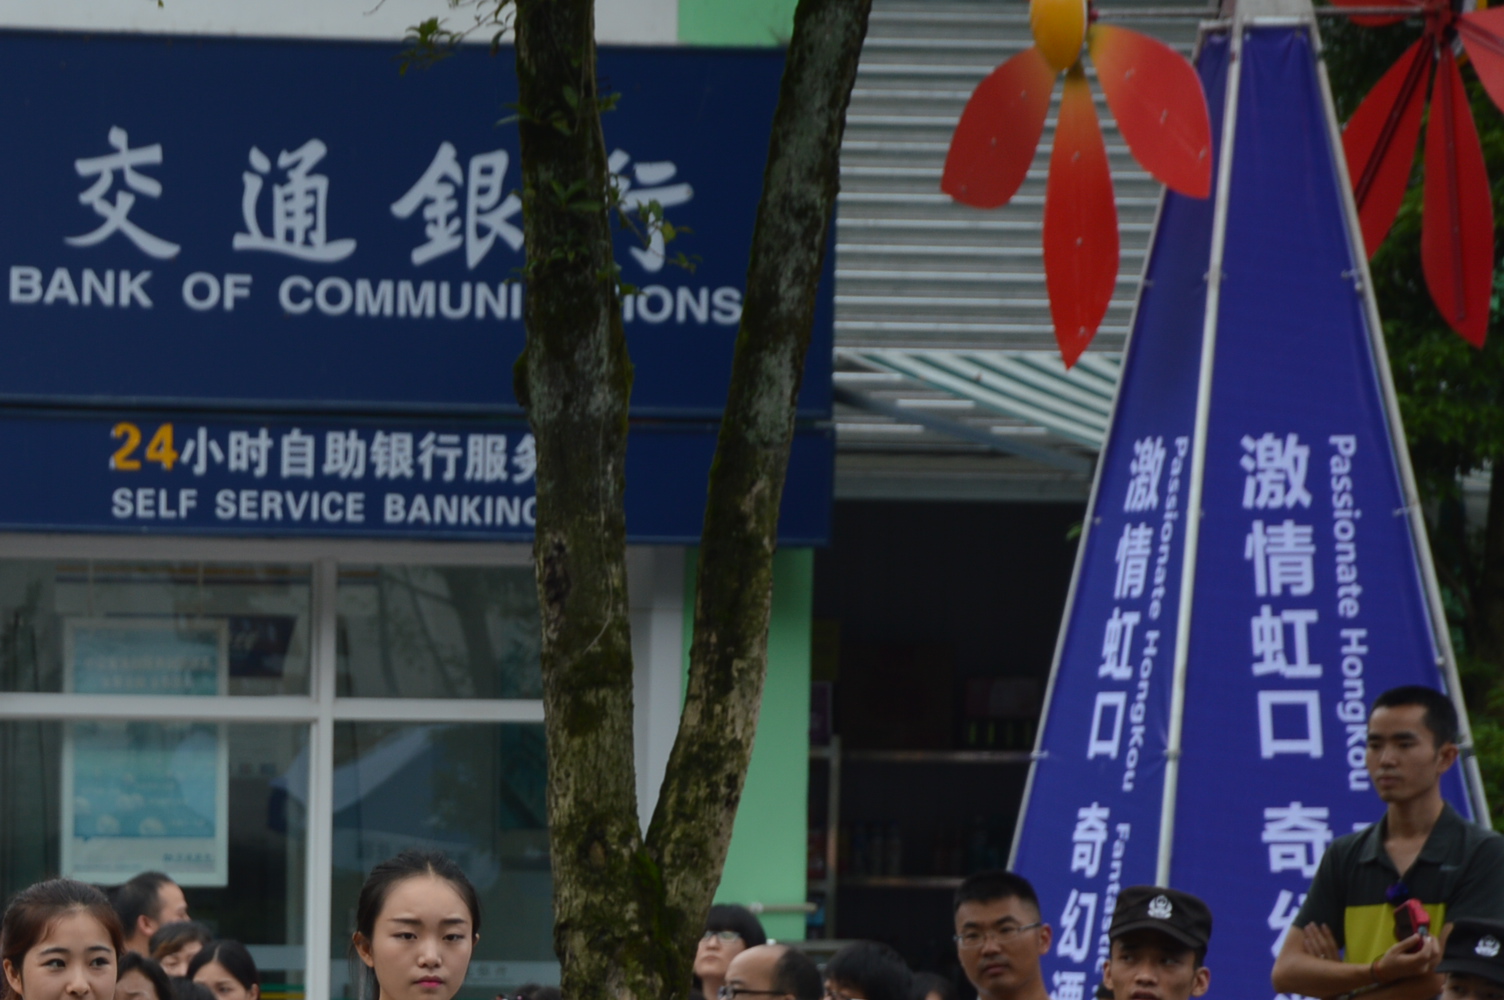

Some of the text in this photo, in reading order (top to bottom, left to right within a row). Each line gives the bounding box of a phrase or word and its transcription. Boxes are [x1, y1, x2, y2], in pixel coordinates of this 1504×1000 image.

[8, 265, 745, 326] BANK OF COMMUNIIONS
[111, 487, 199, 520] SELF
[215, 489, 366, 524] SERVICE
[1087, 434, 1165, 761] 激情虹口
[1148, 435, 1190, 621] Passionate
[1239, 432, 1324, 760] 激情虹口
[1329, 434, 1364, 620] Passionate
